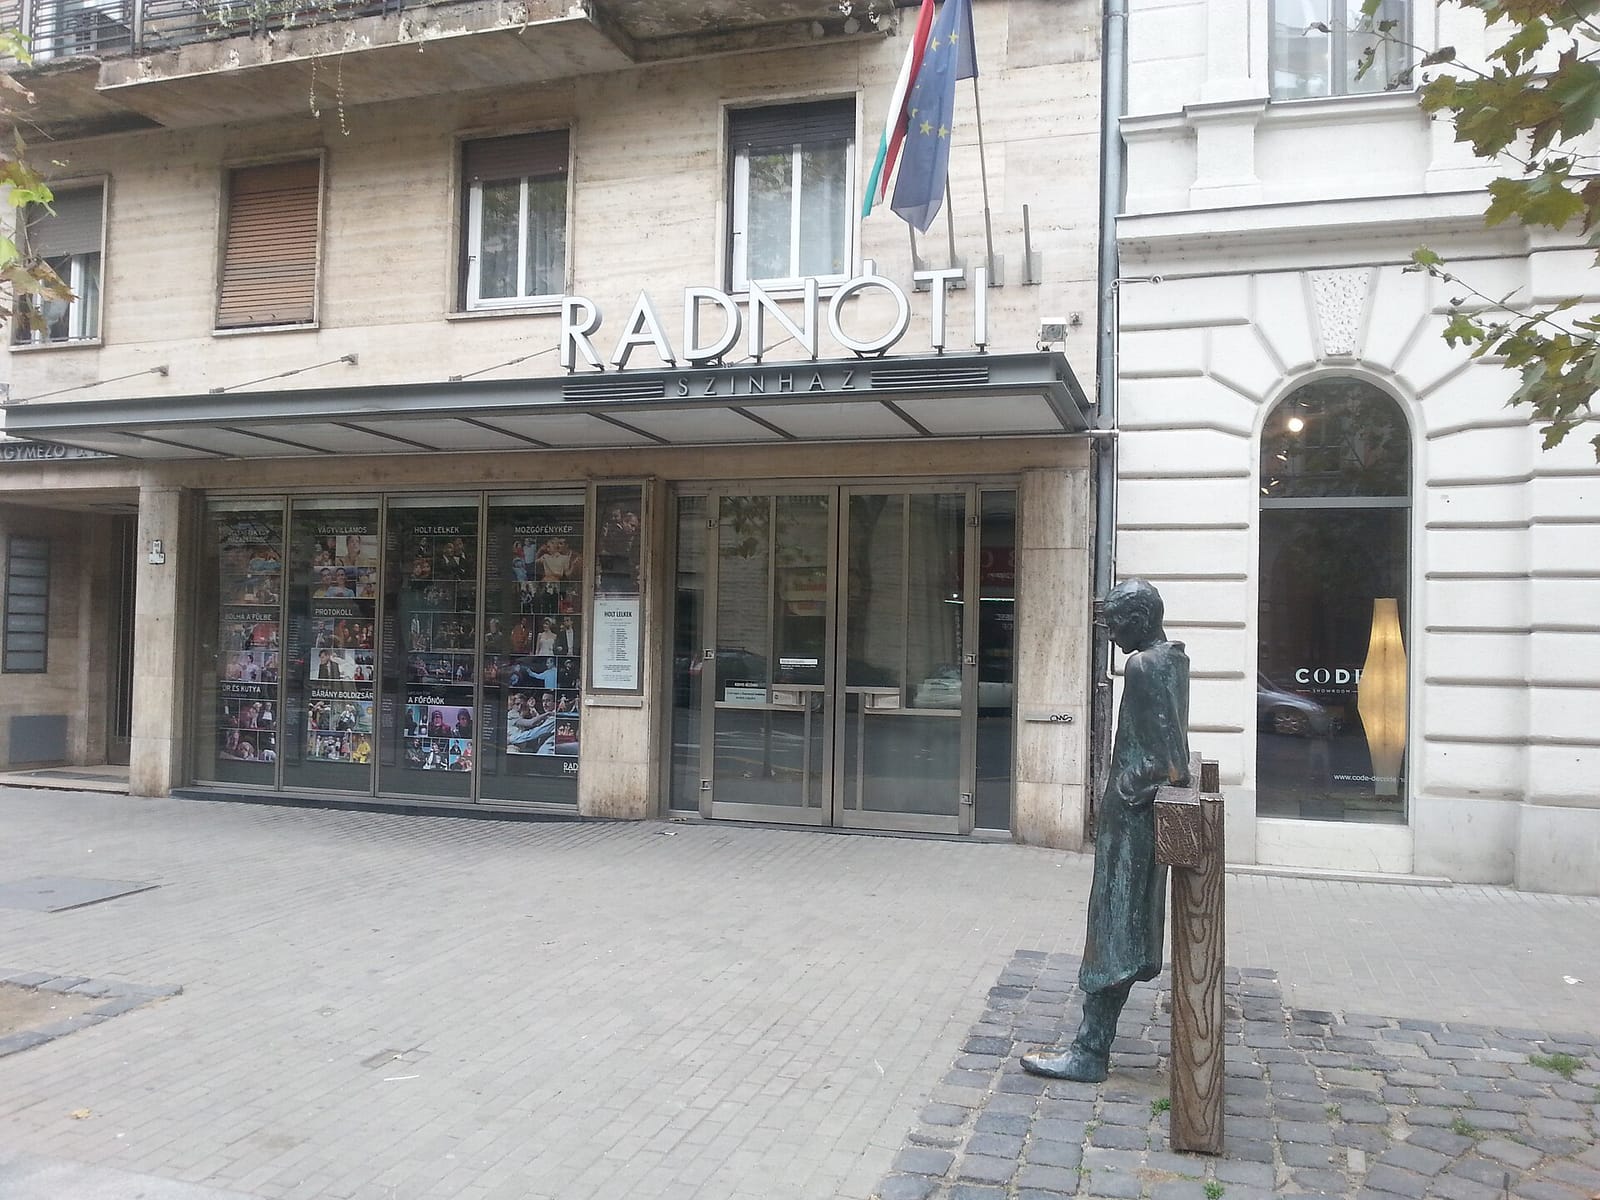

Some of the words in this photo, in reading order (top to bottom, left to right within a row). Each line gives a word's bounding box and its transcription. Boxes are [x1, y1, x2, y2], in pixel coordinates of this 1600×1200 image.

[560, 259, 988, 373] RADNÓTI
[677, 370, 855, 396] SZINHAZ
[414, 526, 432, 534] HOLT
[433, 526, 460, 534] LELKEK
[514, 524, 573, 534] MOZGÓFÉNYKÉP
[315, 608, 353, 616] PROTOKOLL
[241, 685, 261, 693] KUTYA
[311, 689, 338, 698] BÁRÁNY
[338, 691, 374, 699] BOLDIZSÁR
[407, 696, 413, 704] A
[414, 696, 445, 705] FŐFŐNÖK
